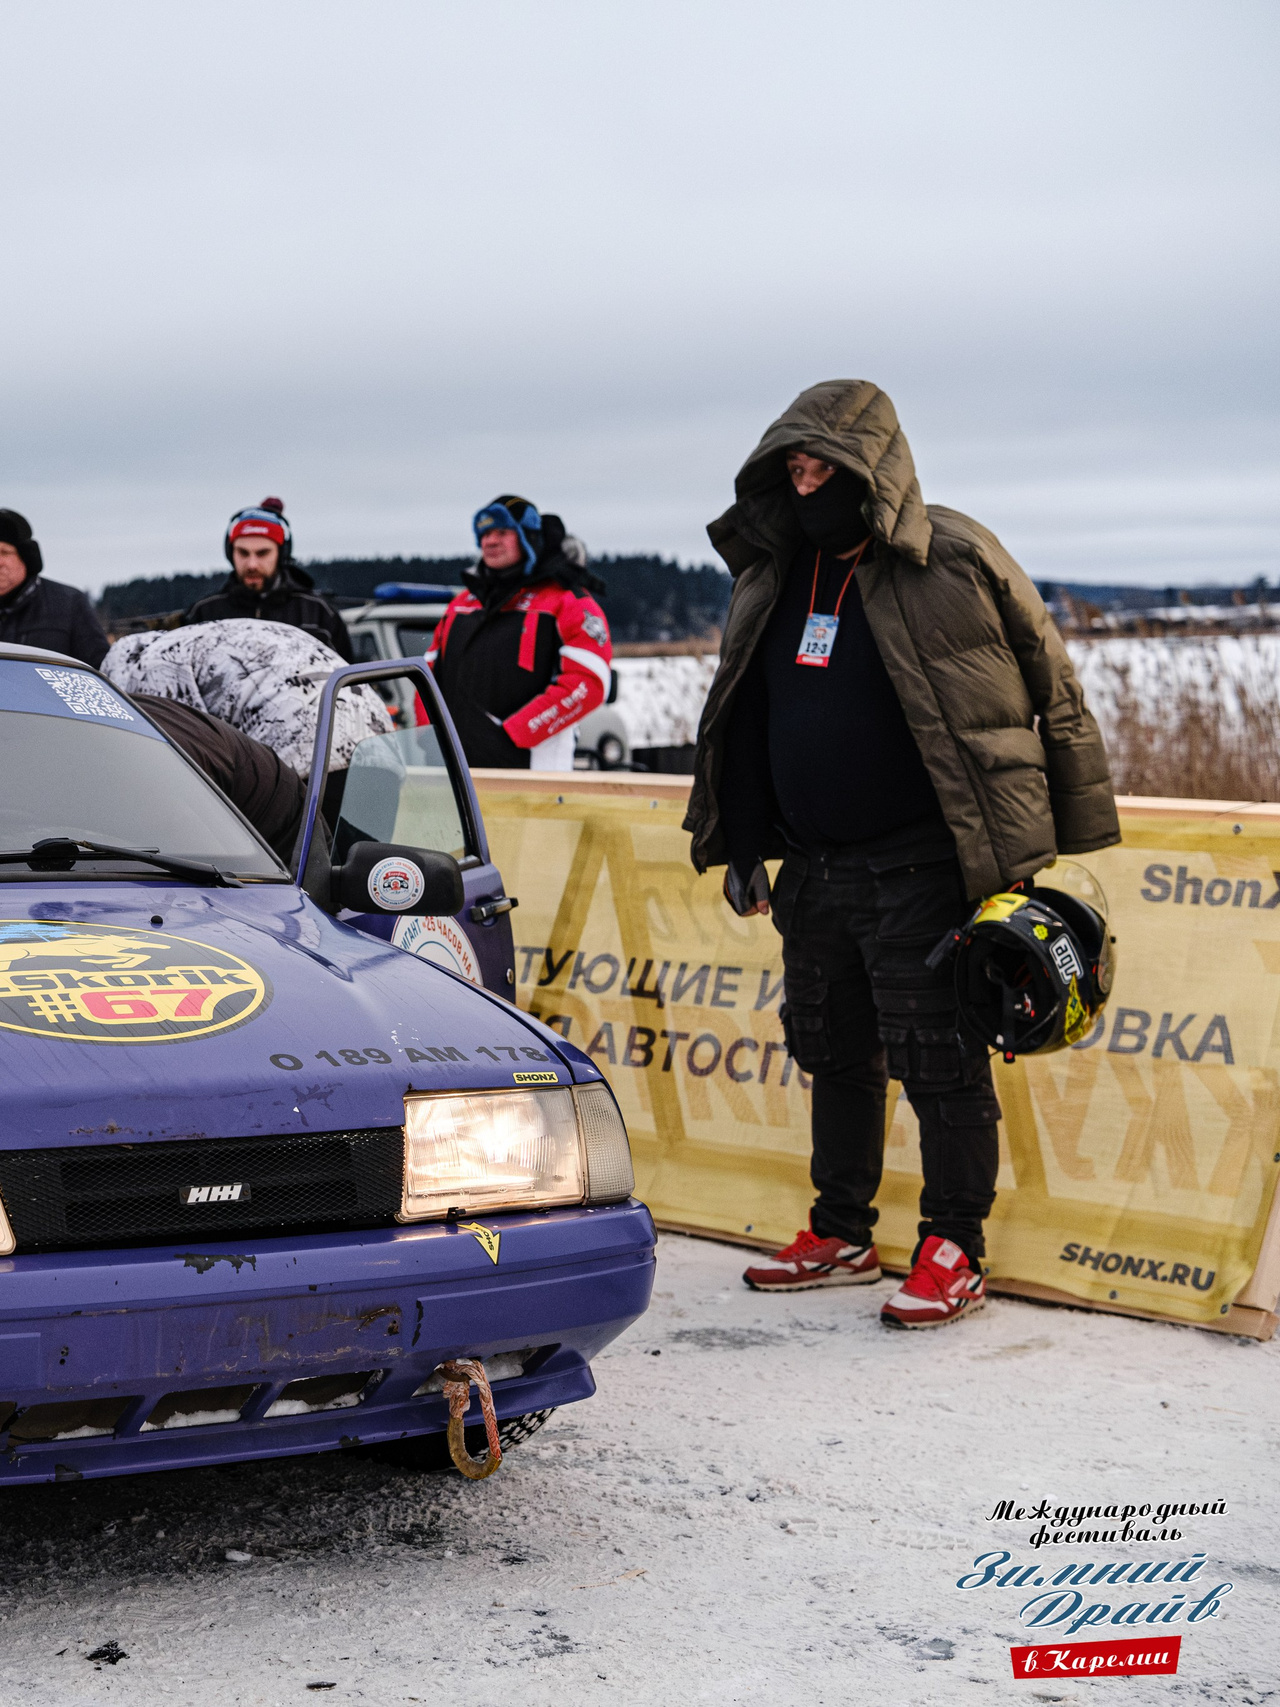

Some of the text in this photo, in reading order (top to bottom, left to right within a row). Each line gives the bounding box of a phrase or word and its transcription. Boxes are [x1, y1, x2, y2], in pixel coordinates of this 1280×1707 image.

[805, 642, 828, 654] 12-3
[400, 918, 422, 950] ИГАНТ
[436, 919, 462, 955] ЧАСОВ
[462, 952, 472, 975] НА
[514, 945, 743, 1009] ТУЮЩИЕ
[28, 988, 214, 1024] #67
[315, 1048, 393, 1067] 189
[475, 1046, 550, 1063] 178
[585, 1022, 813, 1090] АВТОСП
[516, 1073, 557, 1083] SHONX
[1059, 1242, 1216, 1291] SHONX.RU
